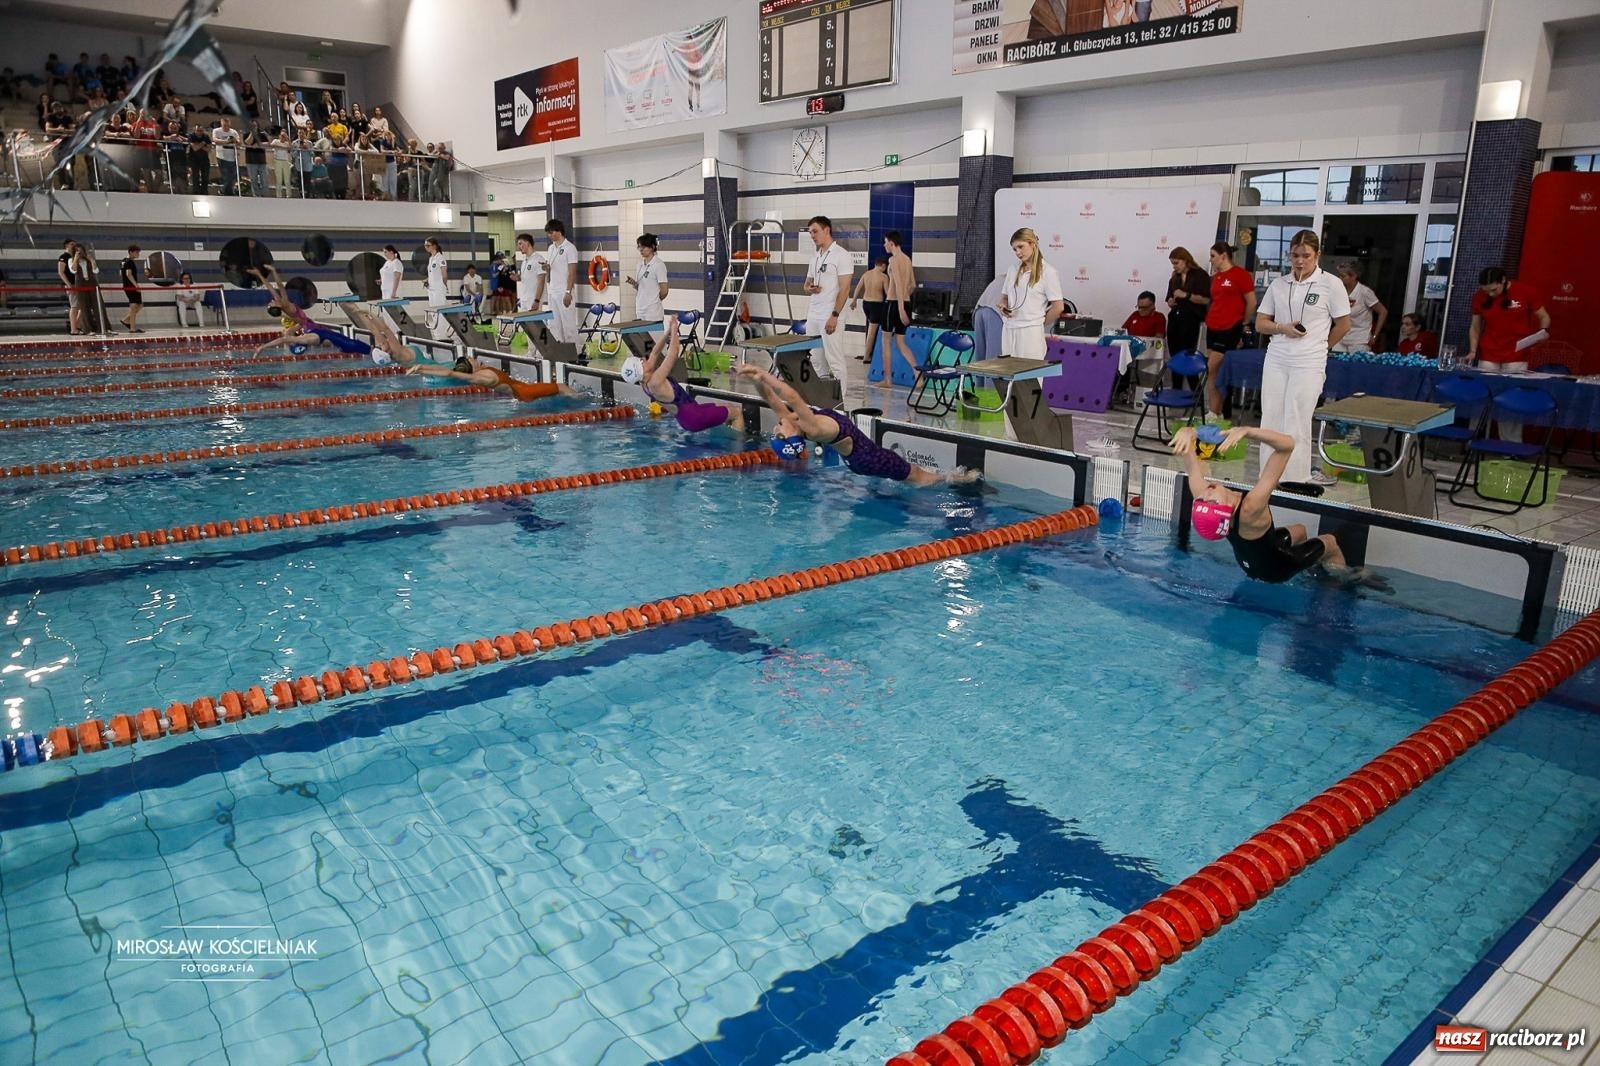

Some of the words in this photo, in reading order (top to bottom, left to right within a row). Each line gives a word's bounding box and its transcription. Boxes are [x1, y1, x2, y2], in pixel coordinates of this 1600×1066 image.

[972, 0, 1000, 14] BRAMY
[826, 20, 834, 30] 5.
[975, 16, 1000, 31] DRZWI
[763, 35, 770, 44] 1.
[826, 38, 834, 49] 6.
[970, 33, 999, 49] PANELE
[1007, 40, 1057, 62] RACIBÓRZ
[1060, 42, 1071, 54] ul.
[1073, 35, 1121, 52] Głubczycka
[1124, 31, 1138, 45] 13,
[1141, 28, 1157, 41] tel:
[1159, 25, 1171, 38] 32
[1180, 21, 1199, 35] 415
[1202, 19, 1215, 32] 25
[1217, 16, 1231, 29] 00
[762, 52, 770, 62] 2.
[825, 57, 833, 67] 7.
[977, 51, 998, 64] OKNA
[762, 70, 770, 79] 3.
[825, 75, 833, 85] 8.
[762, 87, 770, 96] 4.
[536, 89, 576, 113] informacji
[517, 103, 529, 118] rtk
[400, 311, 407, 325] 2
[460, 318, 468, 333] 3
[540, 327, 548, 345] 4
[800, 359, 811, 383] 6
[1031, 388, 1042, 420] 7
[907, 449, 935, 463] Colorado
[1406, 440, 1418, 478] 8
